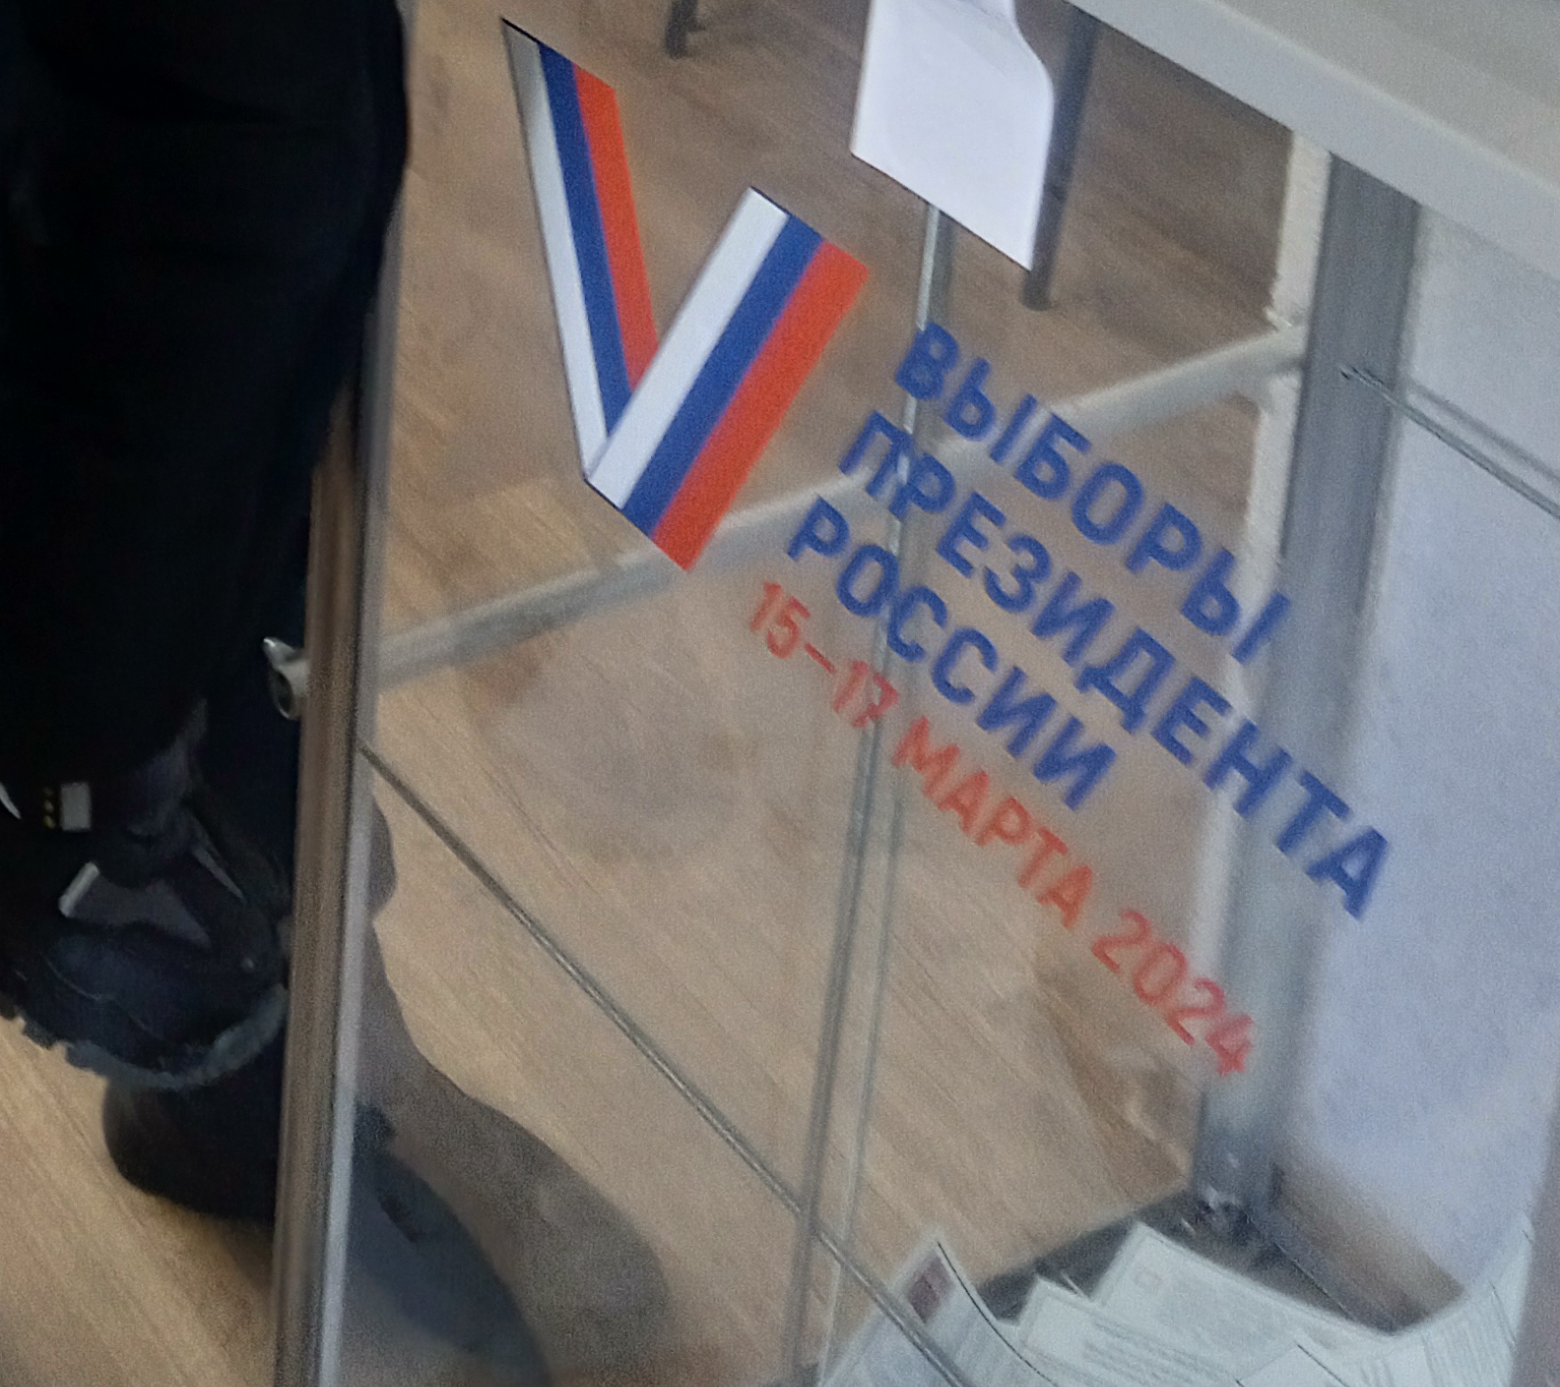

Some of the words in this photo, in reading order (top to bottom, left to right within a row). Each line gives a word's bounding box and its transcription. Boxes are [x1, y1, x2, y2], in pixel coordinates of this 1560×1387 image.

[786, 496, 1118, 811] РОССИИ
[839, 410, 1392, 922] ПРЕЗИДЕНТА
[892, 321, 1292, 664] ВЫБОРЫ
[891, 715, 1095, 931] МАРТА
[1090, 908, 1254, 1077] 2024
